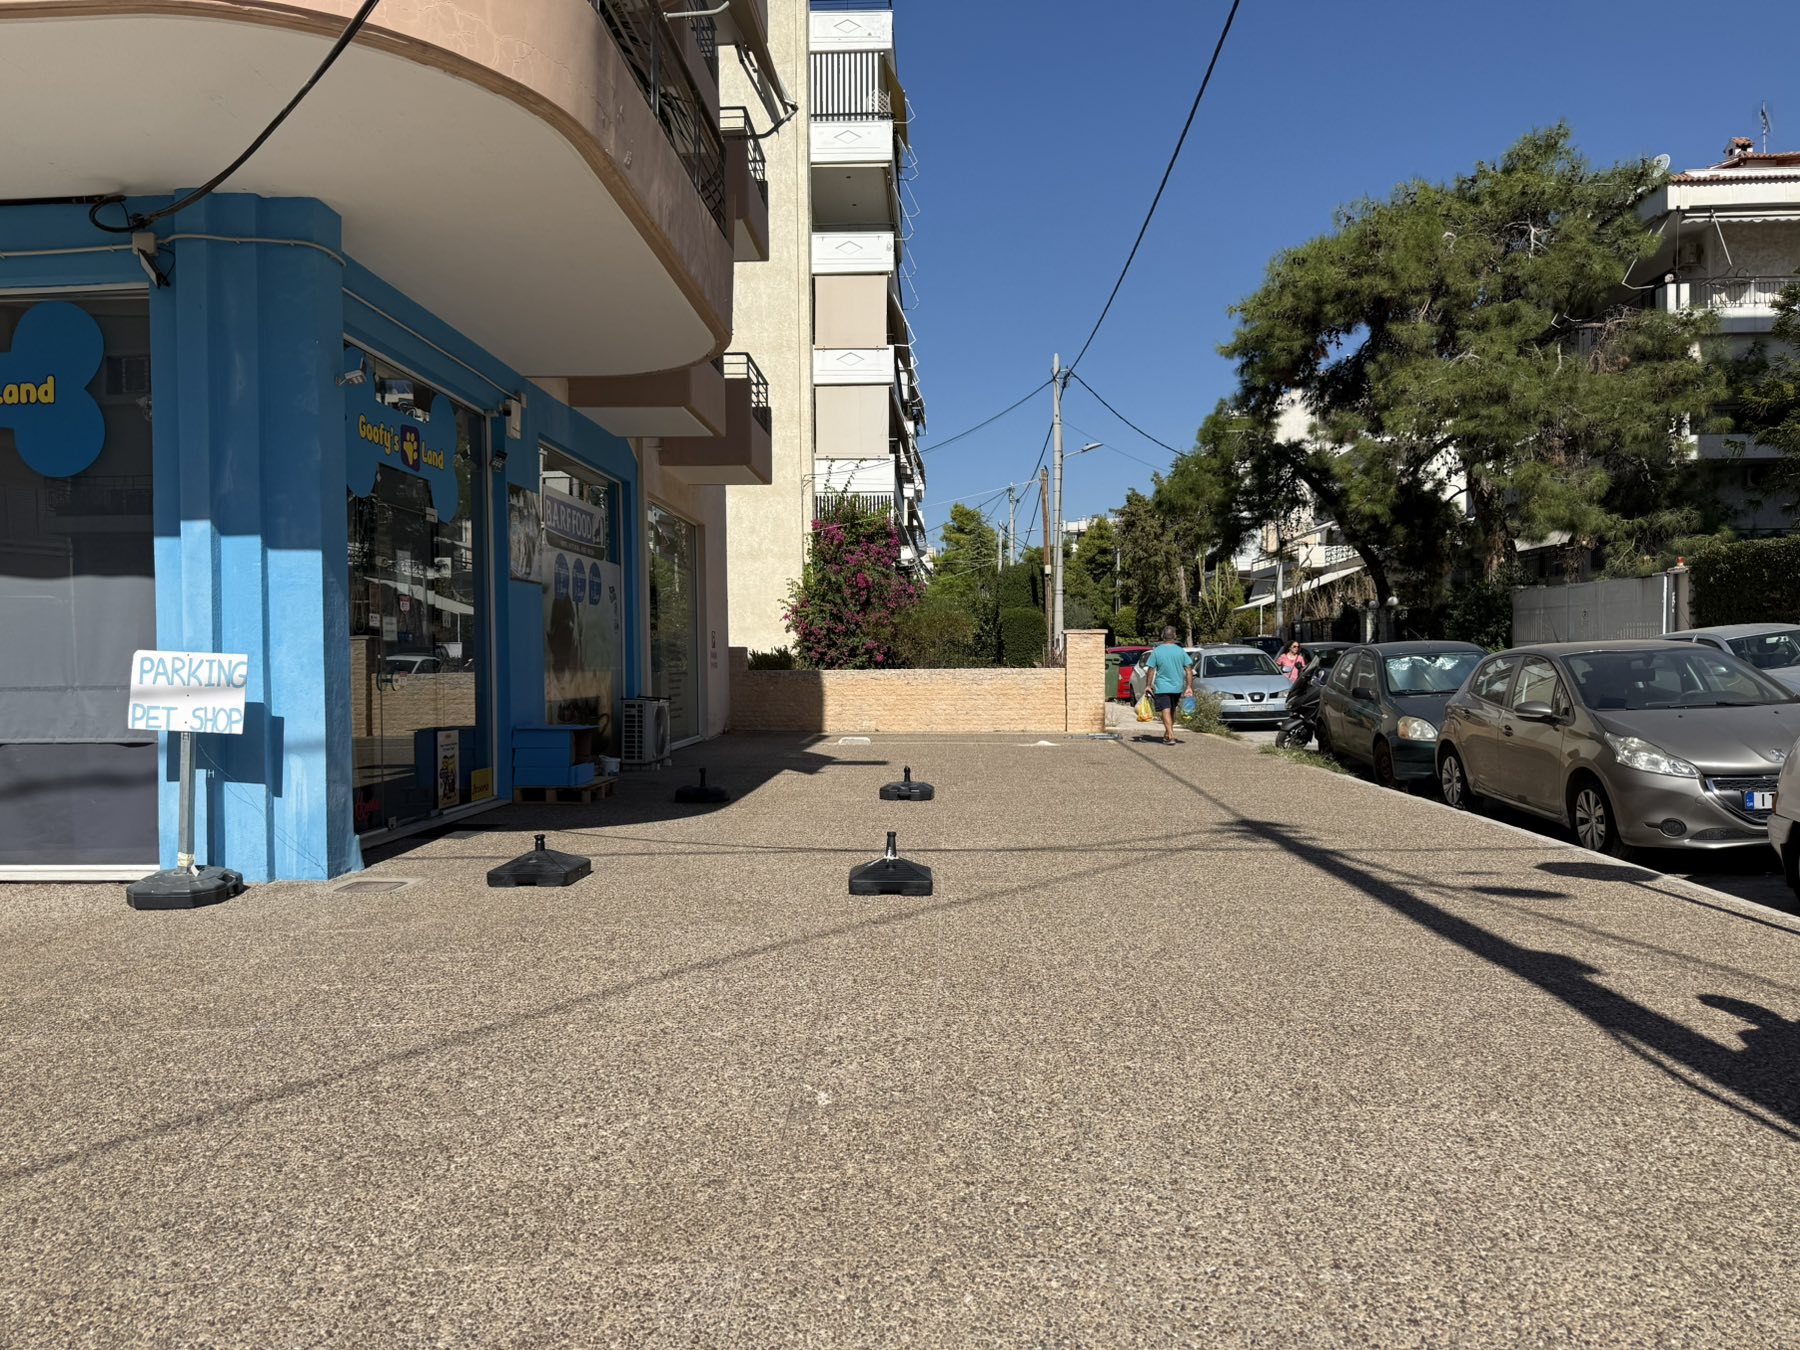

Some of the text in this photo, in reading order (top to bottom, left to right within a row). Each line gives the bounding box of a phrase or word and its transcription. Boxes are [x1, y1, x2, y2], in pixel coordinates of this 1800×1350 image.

[0, 375, 55, 405] and
[358, 413, 445, 470] Goofy's Land
[545, 499, 592, 539] BARF FOOD
[139, 656, 248, 688] PARKING
[131, 703, 243, 734] PET SHOP
